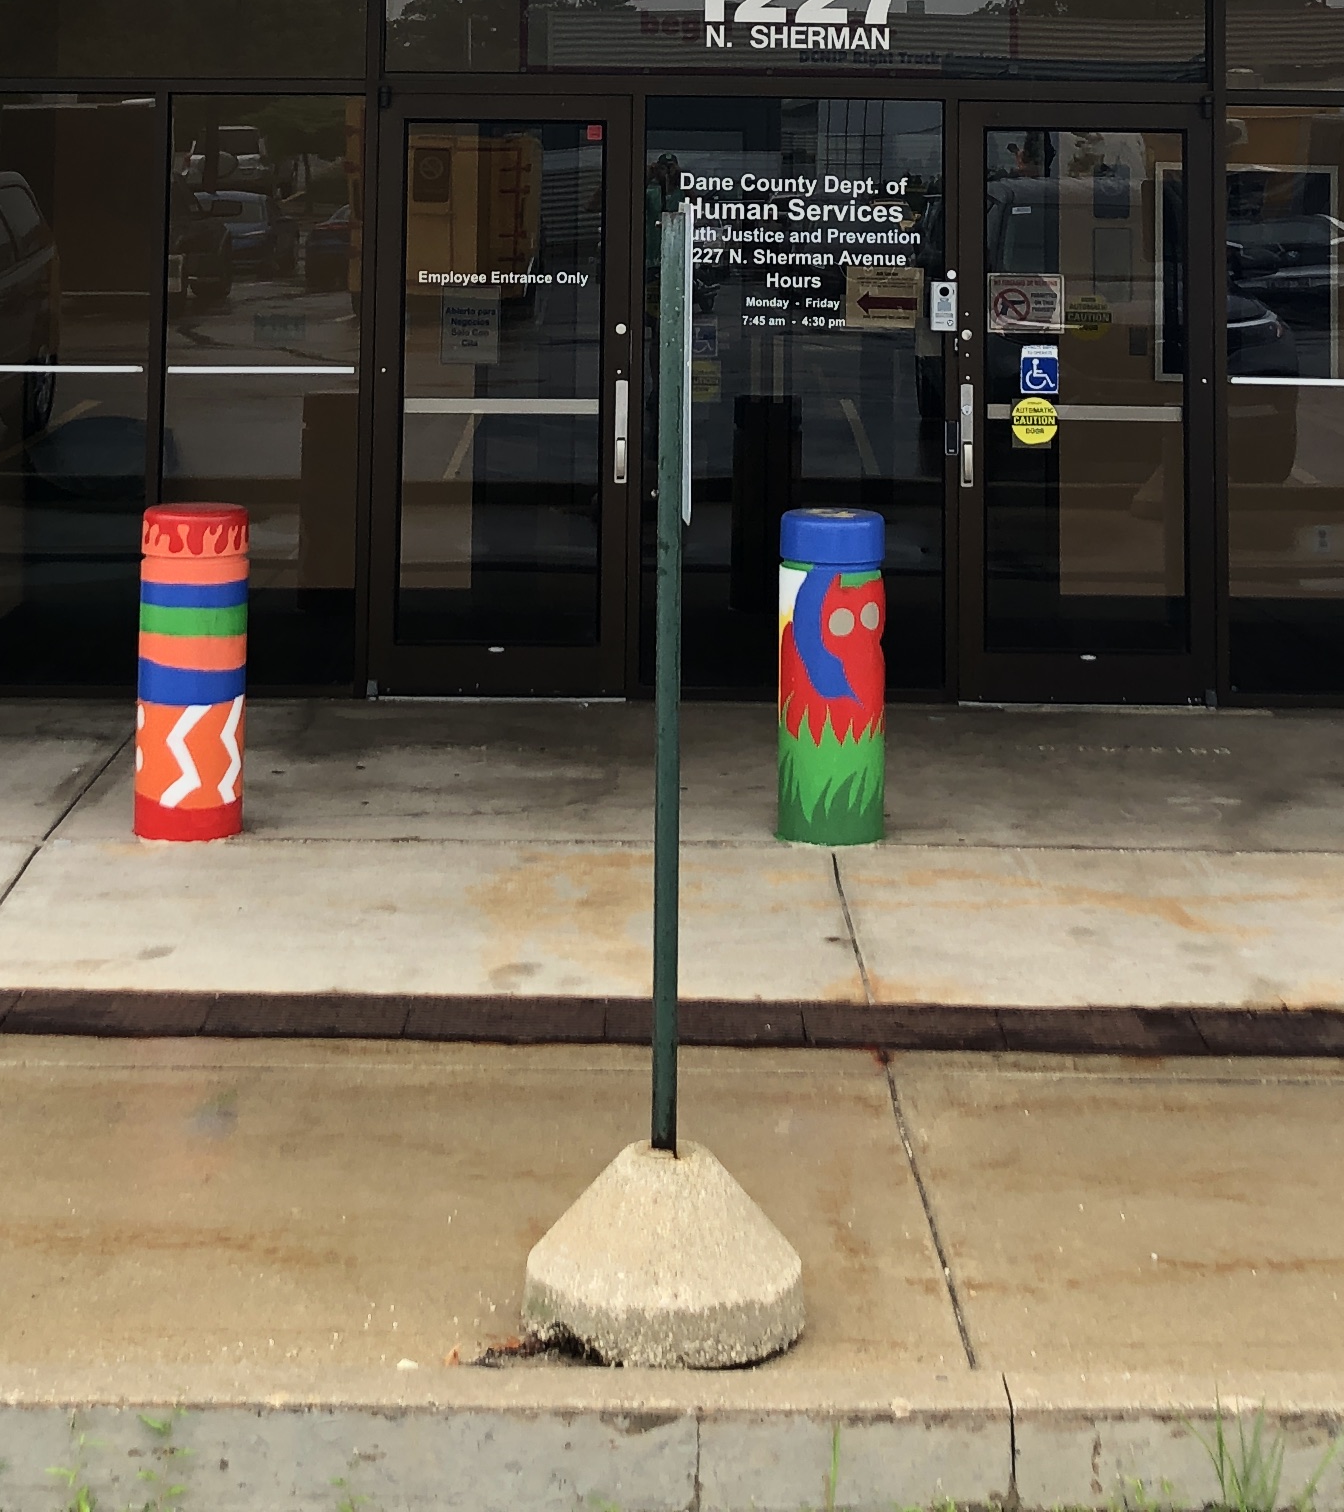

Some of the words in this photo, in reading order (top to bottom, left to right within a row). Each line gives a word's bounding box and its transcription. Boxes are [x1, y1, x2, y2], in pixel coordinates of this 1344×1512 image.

[706, 25, 733, 48] N.
[749, 25, 890, 50] SHERMAN
[680, 172, 734, 191] Dane
[741, 173, 817, 197] County
[824, 175, 879, 198] Dept.
[886, 177, 908, 195] of
[684, 197, 778, 220] Human
[788, 199, 904, 223] Services
[722, 226, 785, 243] Justice
[789, 229, 822, 243] and
[827, 229, 921, 244] Prevention
[729, 249, 748, 264] N.
[753, 249, 834, 265] Sherman
[838, 250, 907, 266] Avenue
[418, 270, 487, 286] Employee
[491, 271, 552, 284] Entrance
[556, 272, 589, 287] Only
[766, 272, 822, 288] Hours
[745, 296, 789, 310] Monday
[805, 297, 840, 311] Friday
[742, 315, 766, 326] 7:45
[768, 317, 786, 326] am
[801, 316, 826, 326] 4:30
[828, 318, 846, 329] pm
[1067, 312, 1110, 322] CAUTION
[1013, 416, 1056, 425] CAUTION
